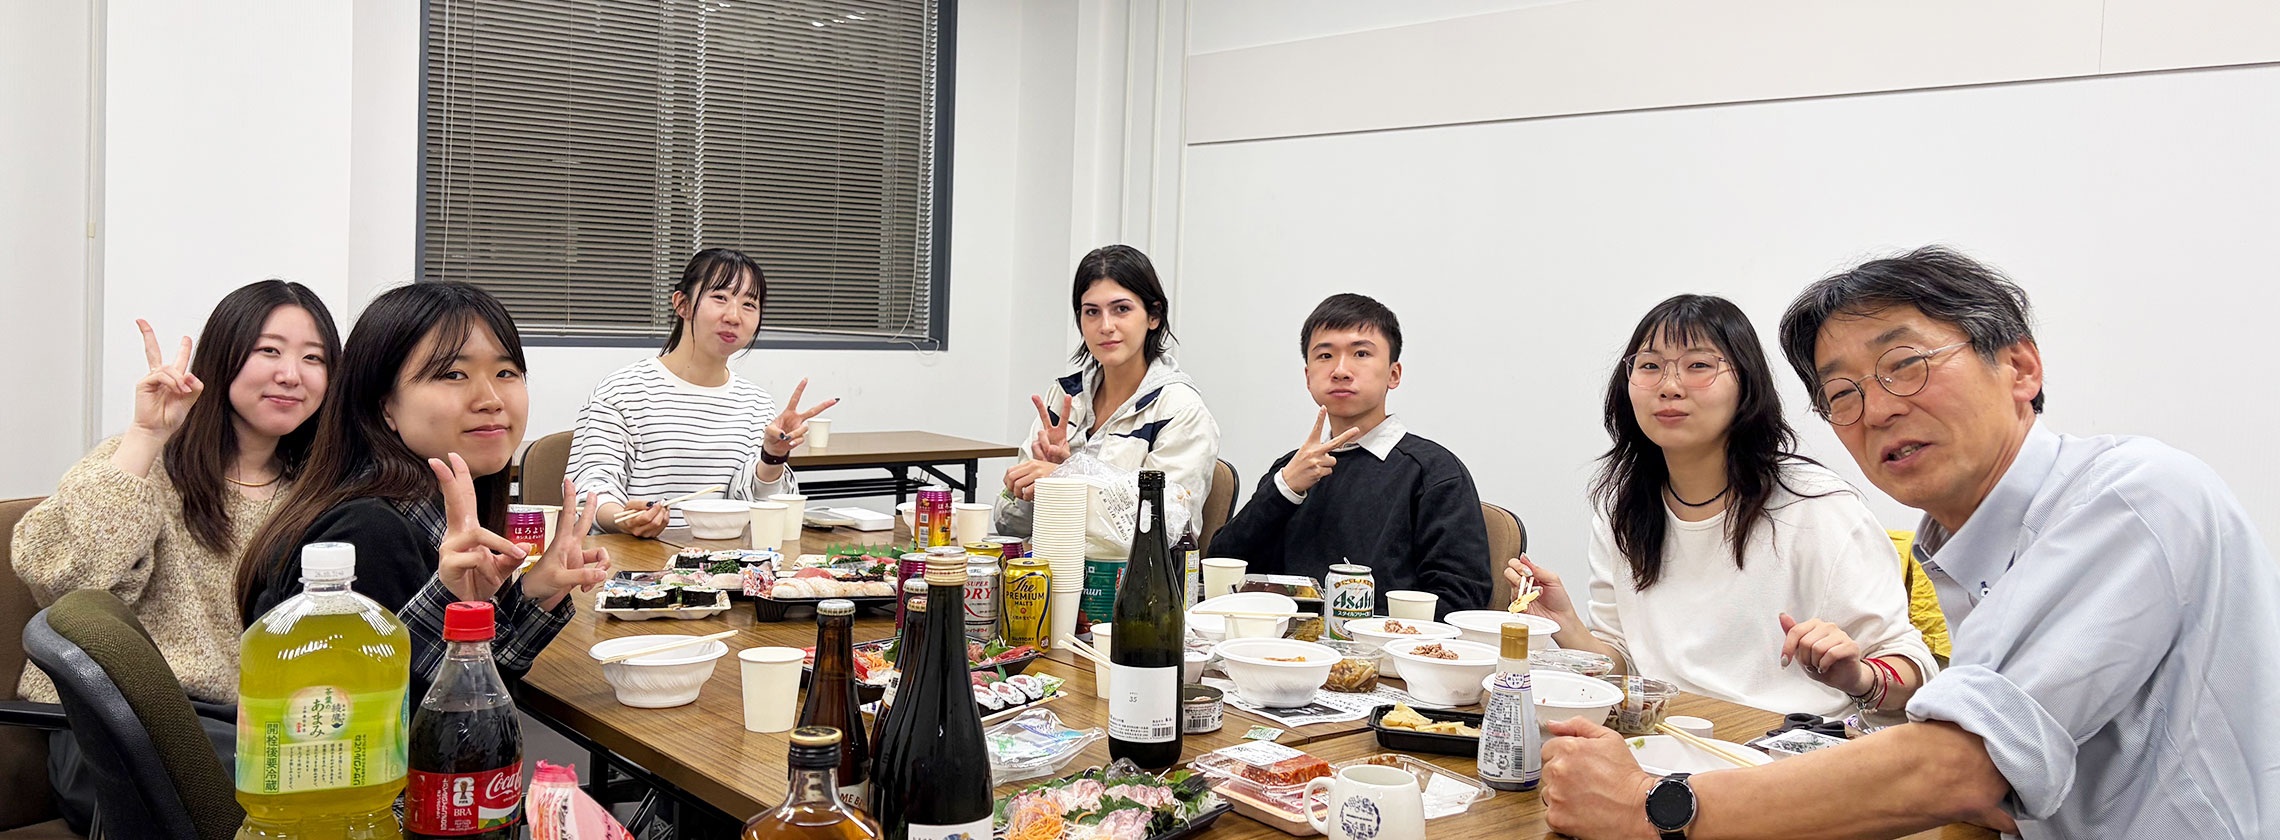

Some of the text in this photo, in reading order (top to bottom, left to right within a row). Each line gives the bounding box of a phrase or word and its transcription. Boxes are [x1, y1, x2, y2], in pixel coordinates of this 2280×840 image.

[514, 527, 545, 535] ほろよい
[1013, 578, 1037, 592] The
[1006, 590, 1045, 601] PREMIUM
[310, 699, 325, 738] あまみ
[265, 723, 280, 791] 開栓後要冷蔵
[353, 734, 362, 786] リサイクルしてね
[454, 808, 472, 817] BRA
